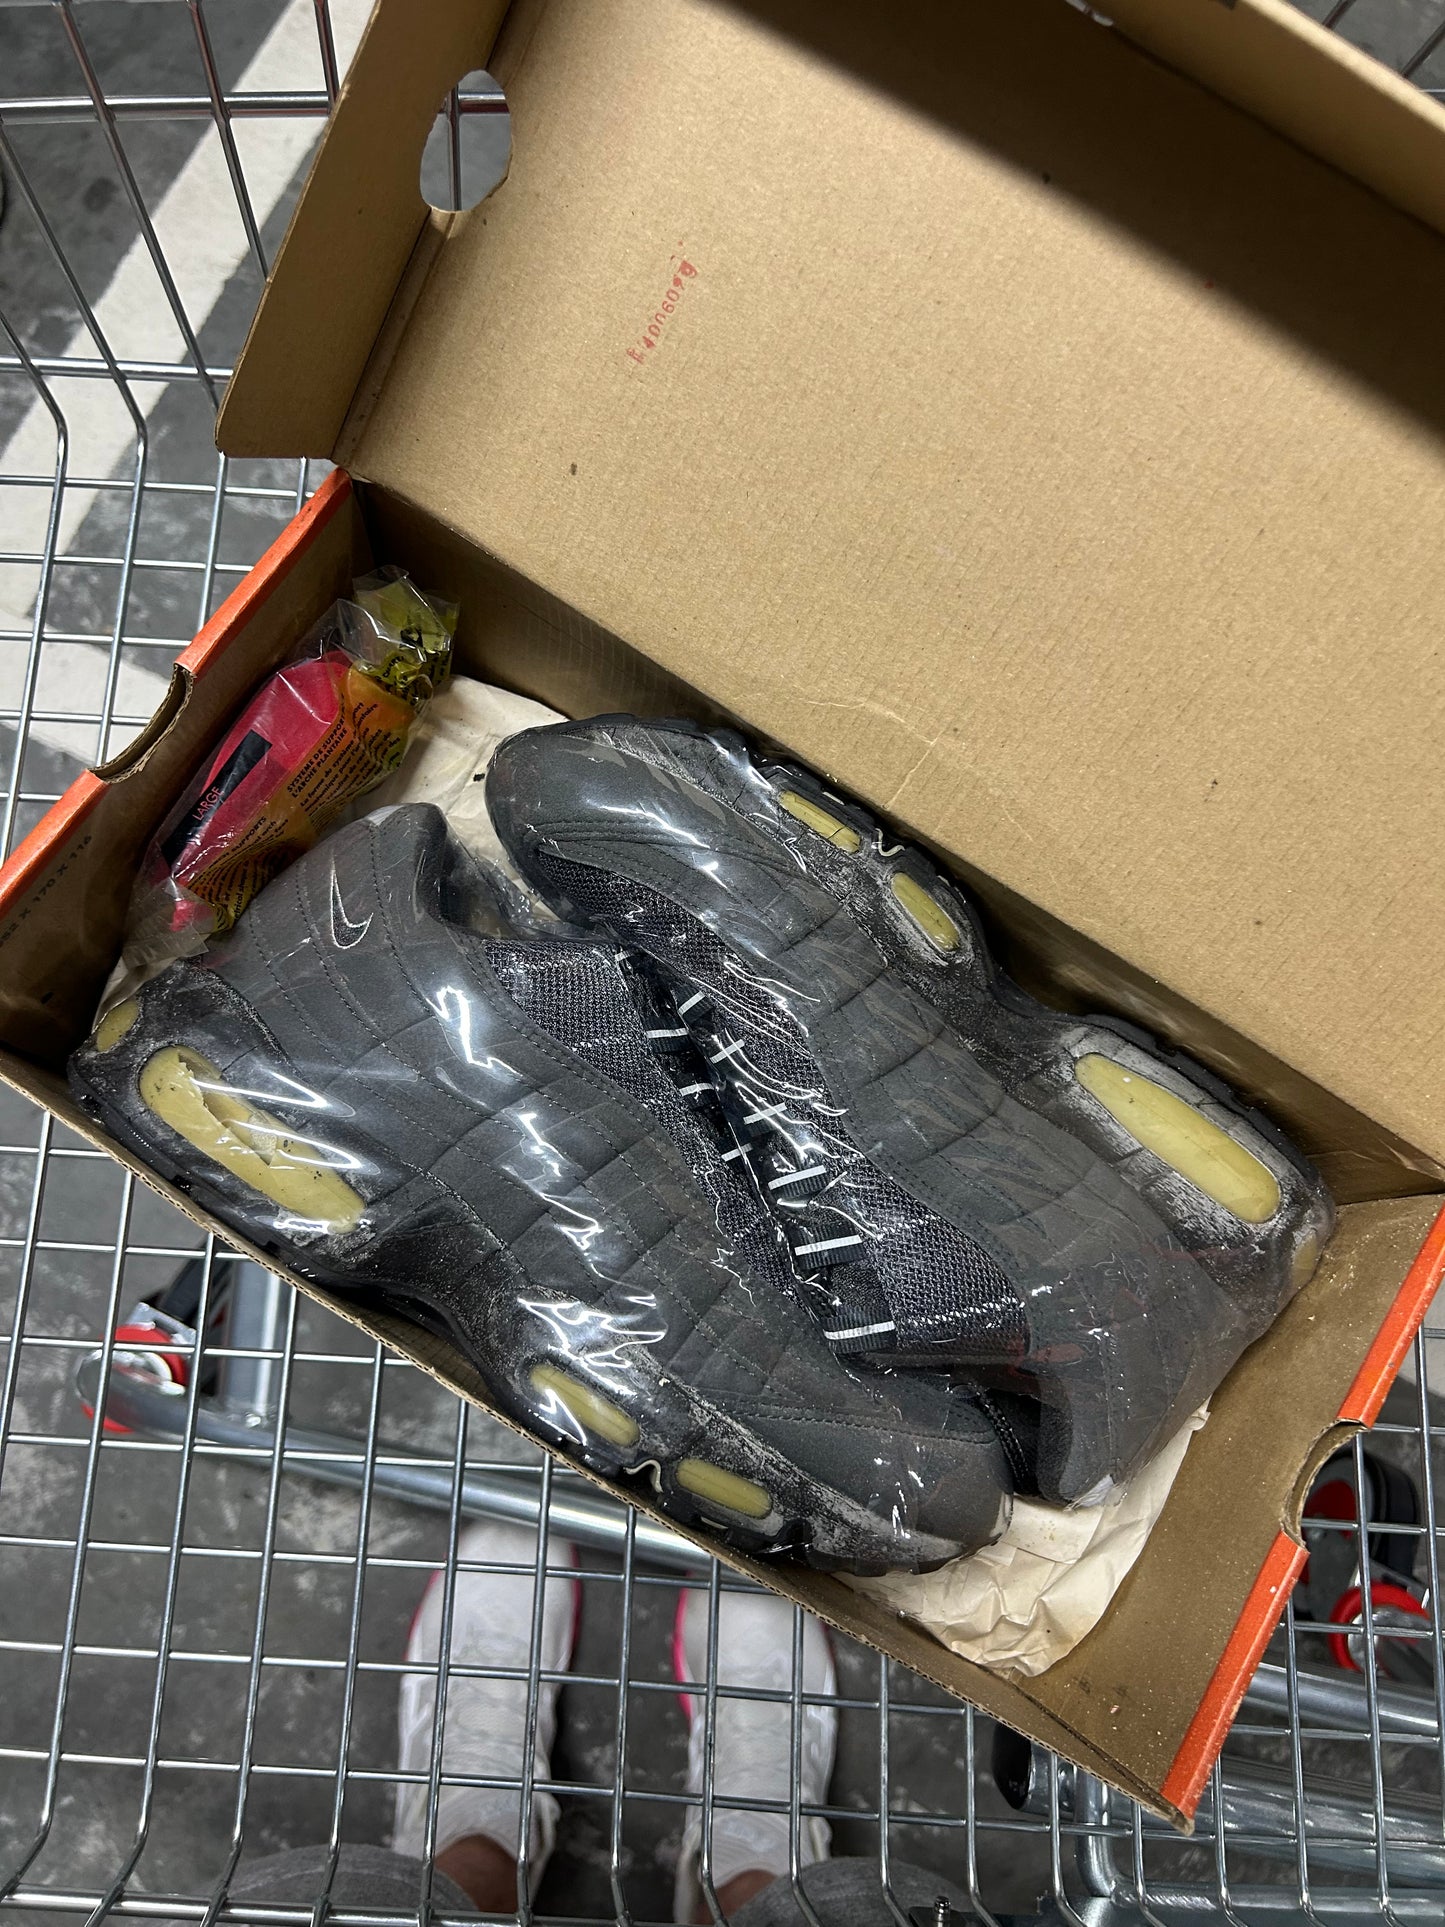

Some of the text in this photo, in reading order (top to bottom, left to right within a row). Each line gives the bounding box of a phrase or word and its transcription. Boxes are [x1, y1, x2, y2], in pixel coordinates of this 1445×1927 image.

[315, 727, 348, 768] PLANTAIRE
[286, 758, 314, 793] SYSTEME
[312, 748, 323, 760] DE
[191, 785, 224, 822] LARGE
[19, 907, 31, 919] X
[33, 878, 56, 902] 170
[57, 863, 68, 876] X
[70, 836, 92, 859] 116
